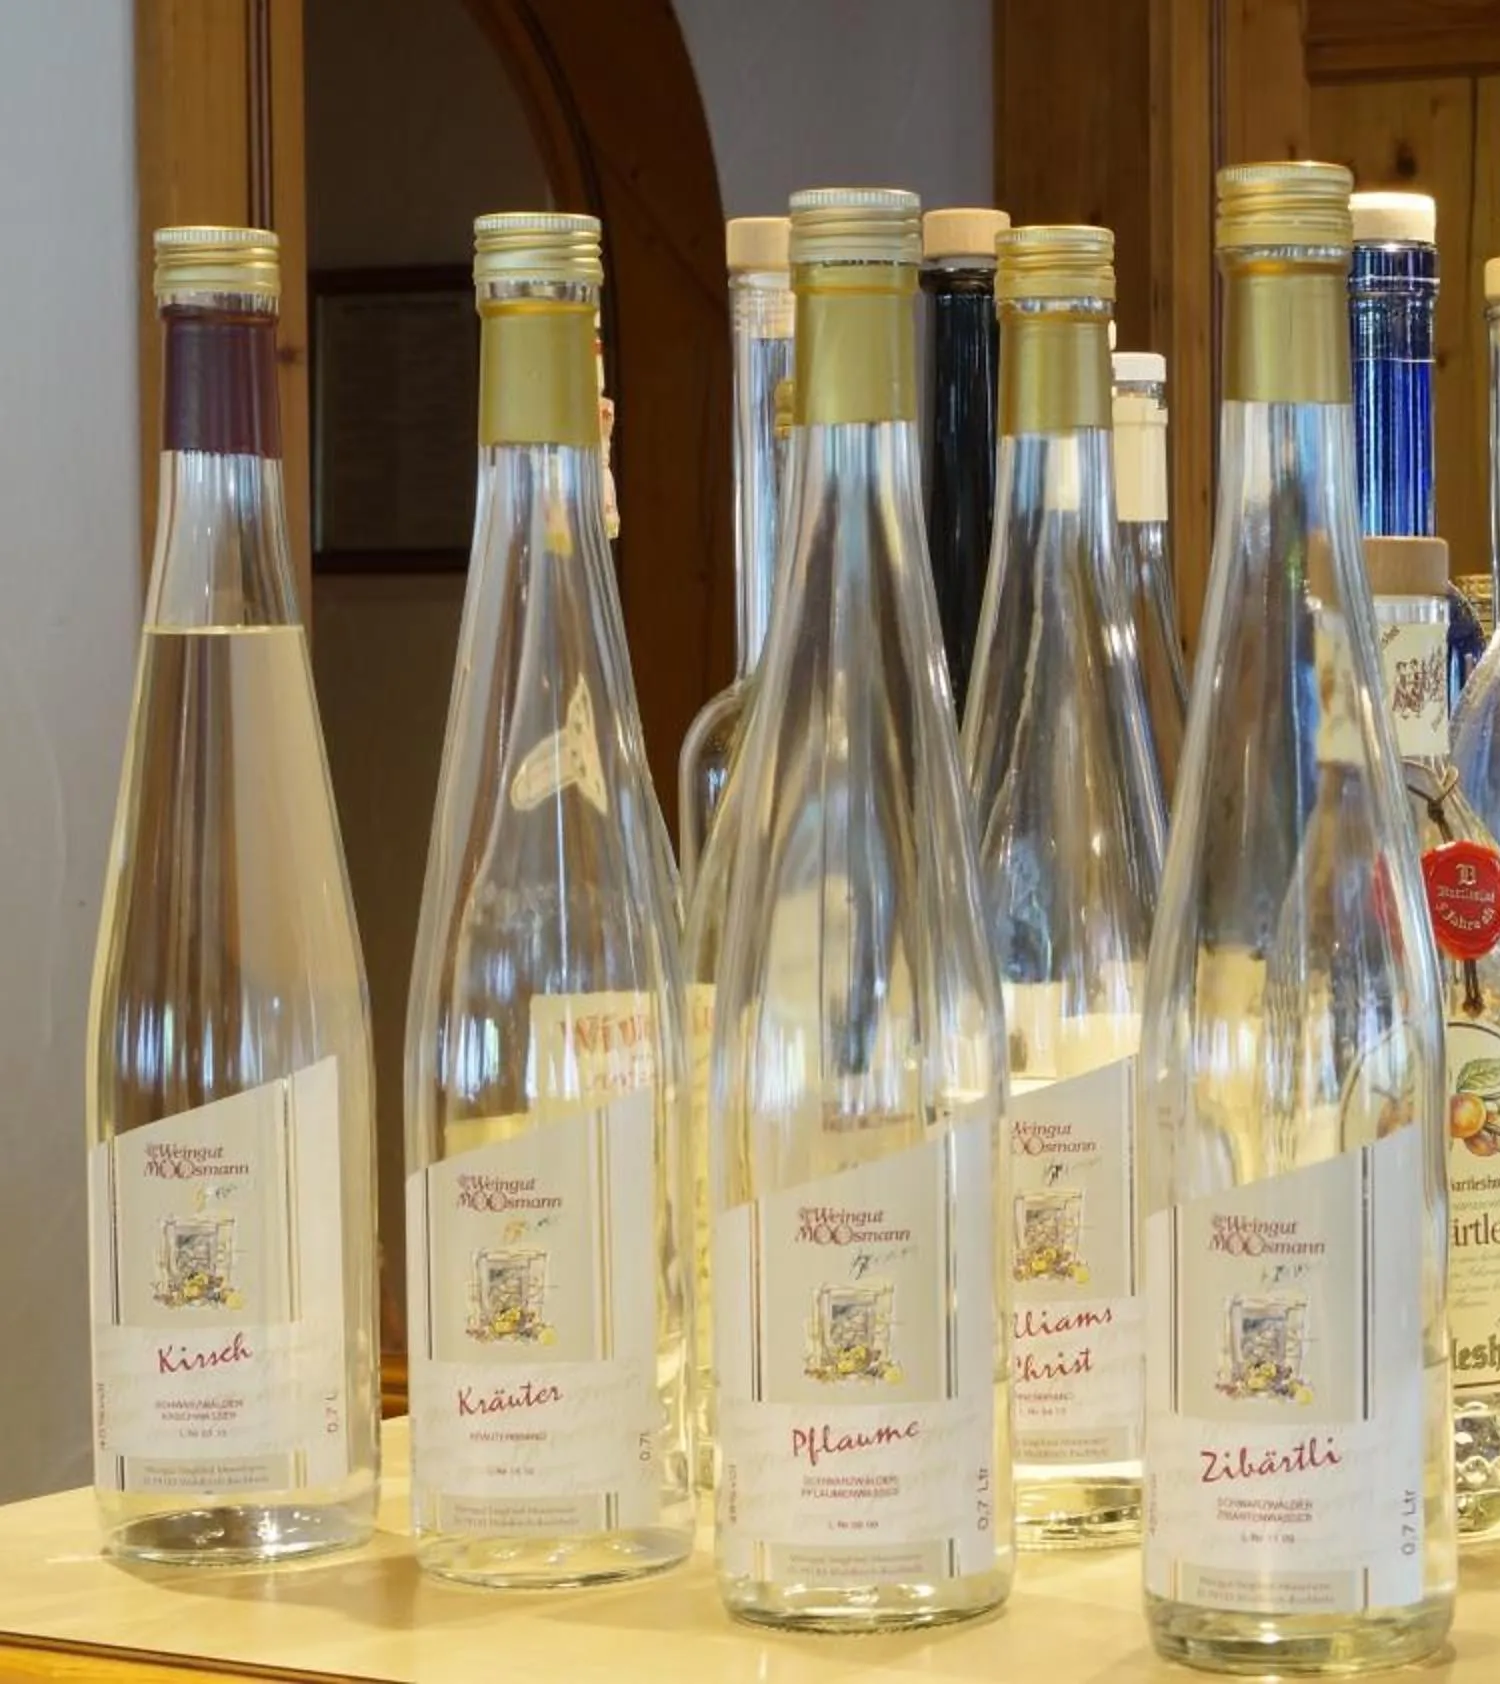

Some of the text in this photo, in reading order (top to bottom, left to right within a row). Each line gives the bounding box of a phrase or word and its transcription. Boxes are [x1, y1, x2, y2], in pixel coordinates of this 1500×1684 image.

[158, 1143, 224, 1161] Weingut
[468, 1175, 535, 1195] Weingut
[813, 1207, 884, 1228] Weingut
[1224, 1215, 1298, 1238] Weingut
[157, 1332, 253, 1374] Kirsch
[457, 1382, 564, 1417] Kräuter
[792, 1419, 921, 1467] Pflaume
[1200, 1437, 1343, 1484] Zibärtli
